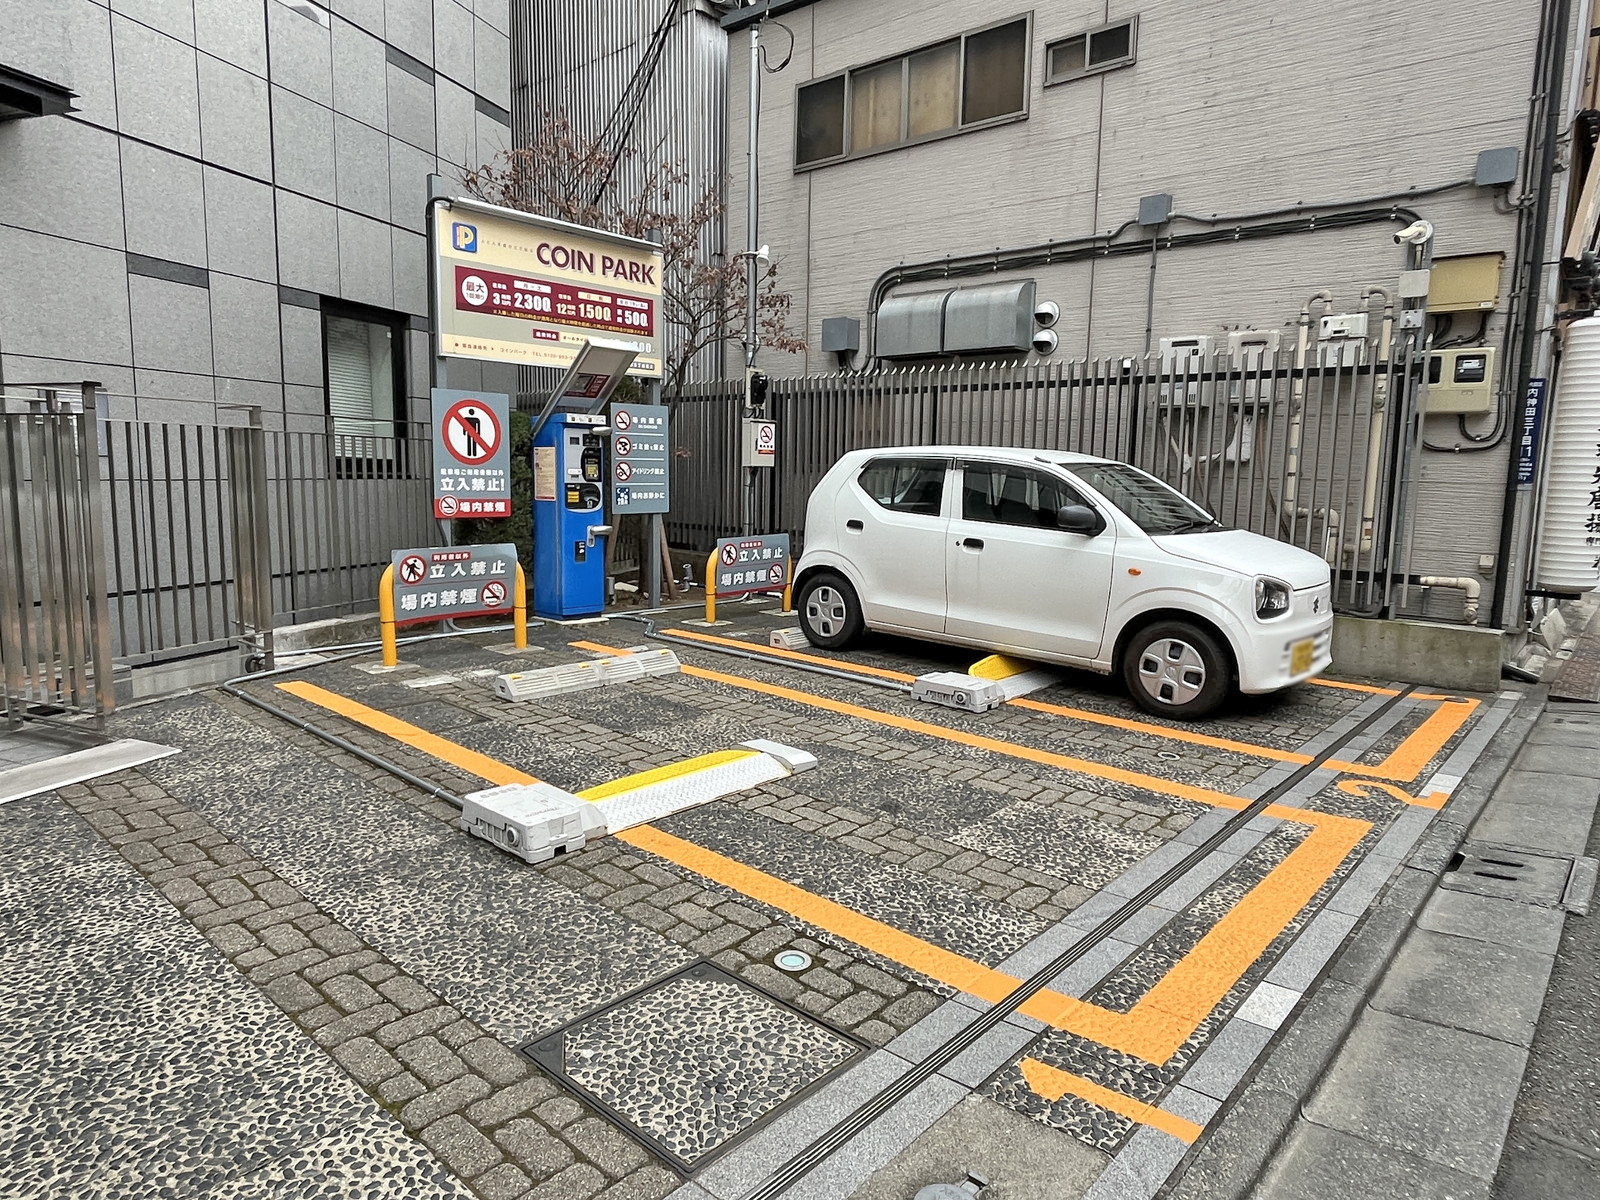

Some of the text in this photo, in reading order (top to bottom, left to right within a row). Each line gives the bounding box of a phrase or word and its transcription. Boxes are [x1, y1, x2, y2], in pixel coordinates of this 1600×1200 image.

[536, 242, 594, 273] COIN
[601, 255, 655, 285] PARK
[466, 281, 484, 293] 最大
[459, 501, 506, 513] 場内禁煙
[739, 547, 783, 562] 立入禁止
[429, 560, 506, 579] 立入禁止
[721, 569, 767, 586] 場内禁煙
[401, 588, 478, 611] 場内禁煙
[1337, 779, 1449, 810] 2
[1018, 1057, 1204, 1144] 1
